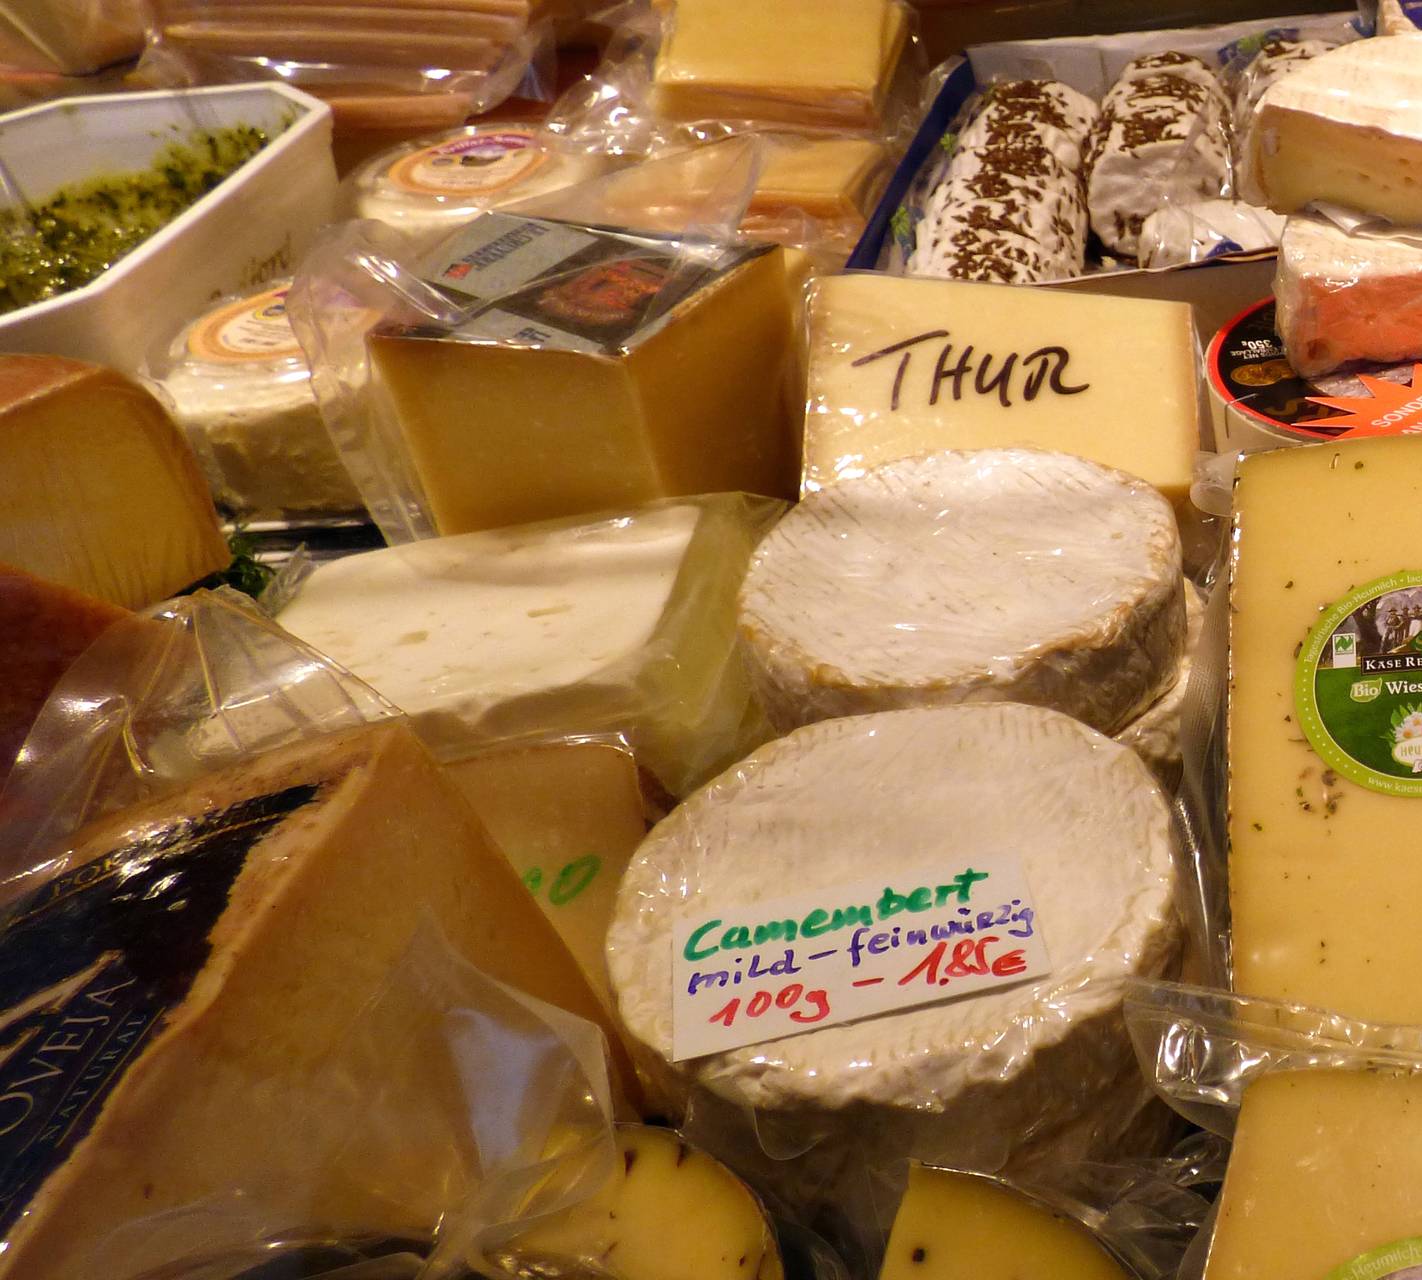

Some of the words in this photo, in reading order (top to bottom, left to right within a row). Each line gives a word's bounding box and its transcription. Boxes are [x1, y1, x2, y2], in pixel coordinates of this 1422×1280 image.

[850, 328, 1091, 412] THUR
[1353, 683, 1380, 697] Bio
[683, 867, 990, 963] Camembert
[708, 983, 831, 1027] 100g
[0, 976, 138, 1136] OVEJA
[39, 1012, 148, 1145] NATURAL
